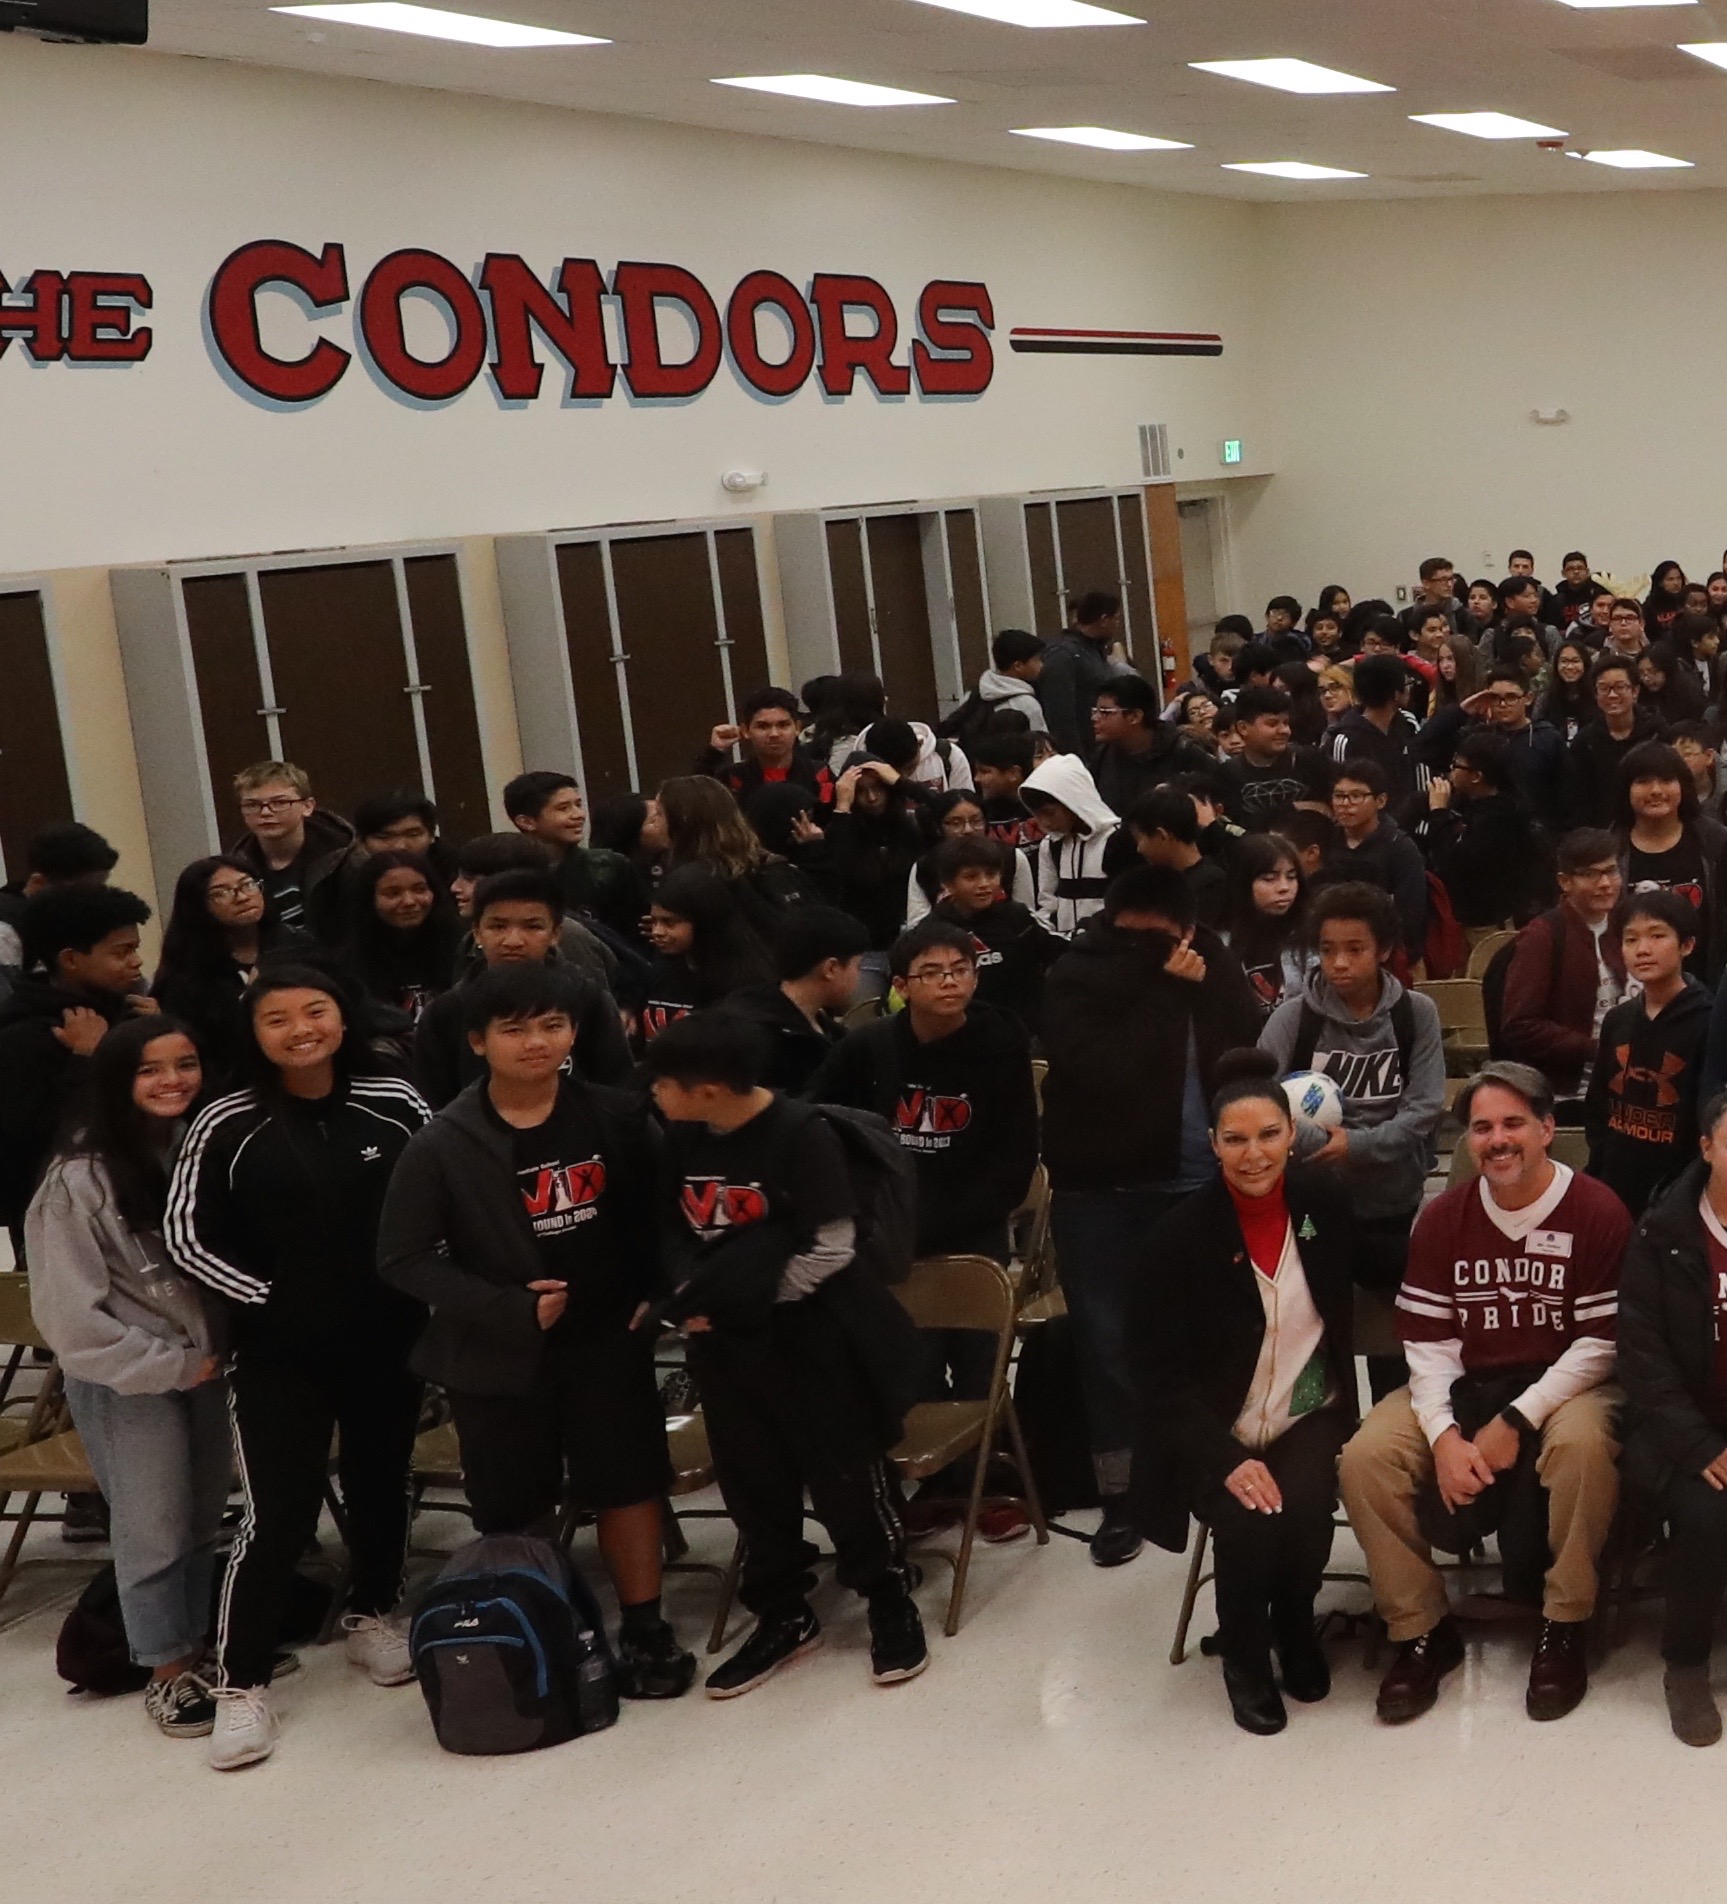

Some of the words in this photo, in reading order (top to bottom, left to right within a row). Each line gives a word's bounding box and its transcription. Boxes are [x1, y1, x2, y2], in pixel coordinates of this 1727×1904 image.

[203, 238, 995, 408] CONDORS
[1322, 1050, 1402, 1100] NIKE
[1454, 1257, 1566, 1290] CONDOR
[1457, 1303, 1565, 1332] PRIDE
